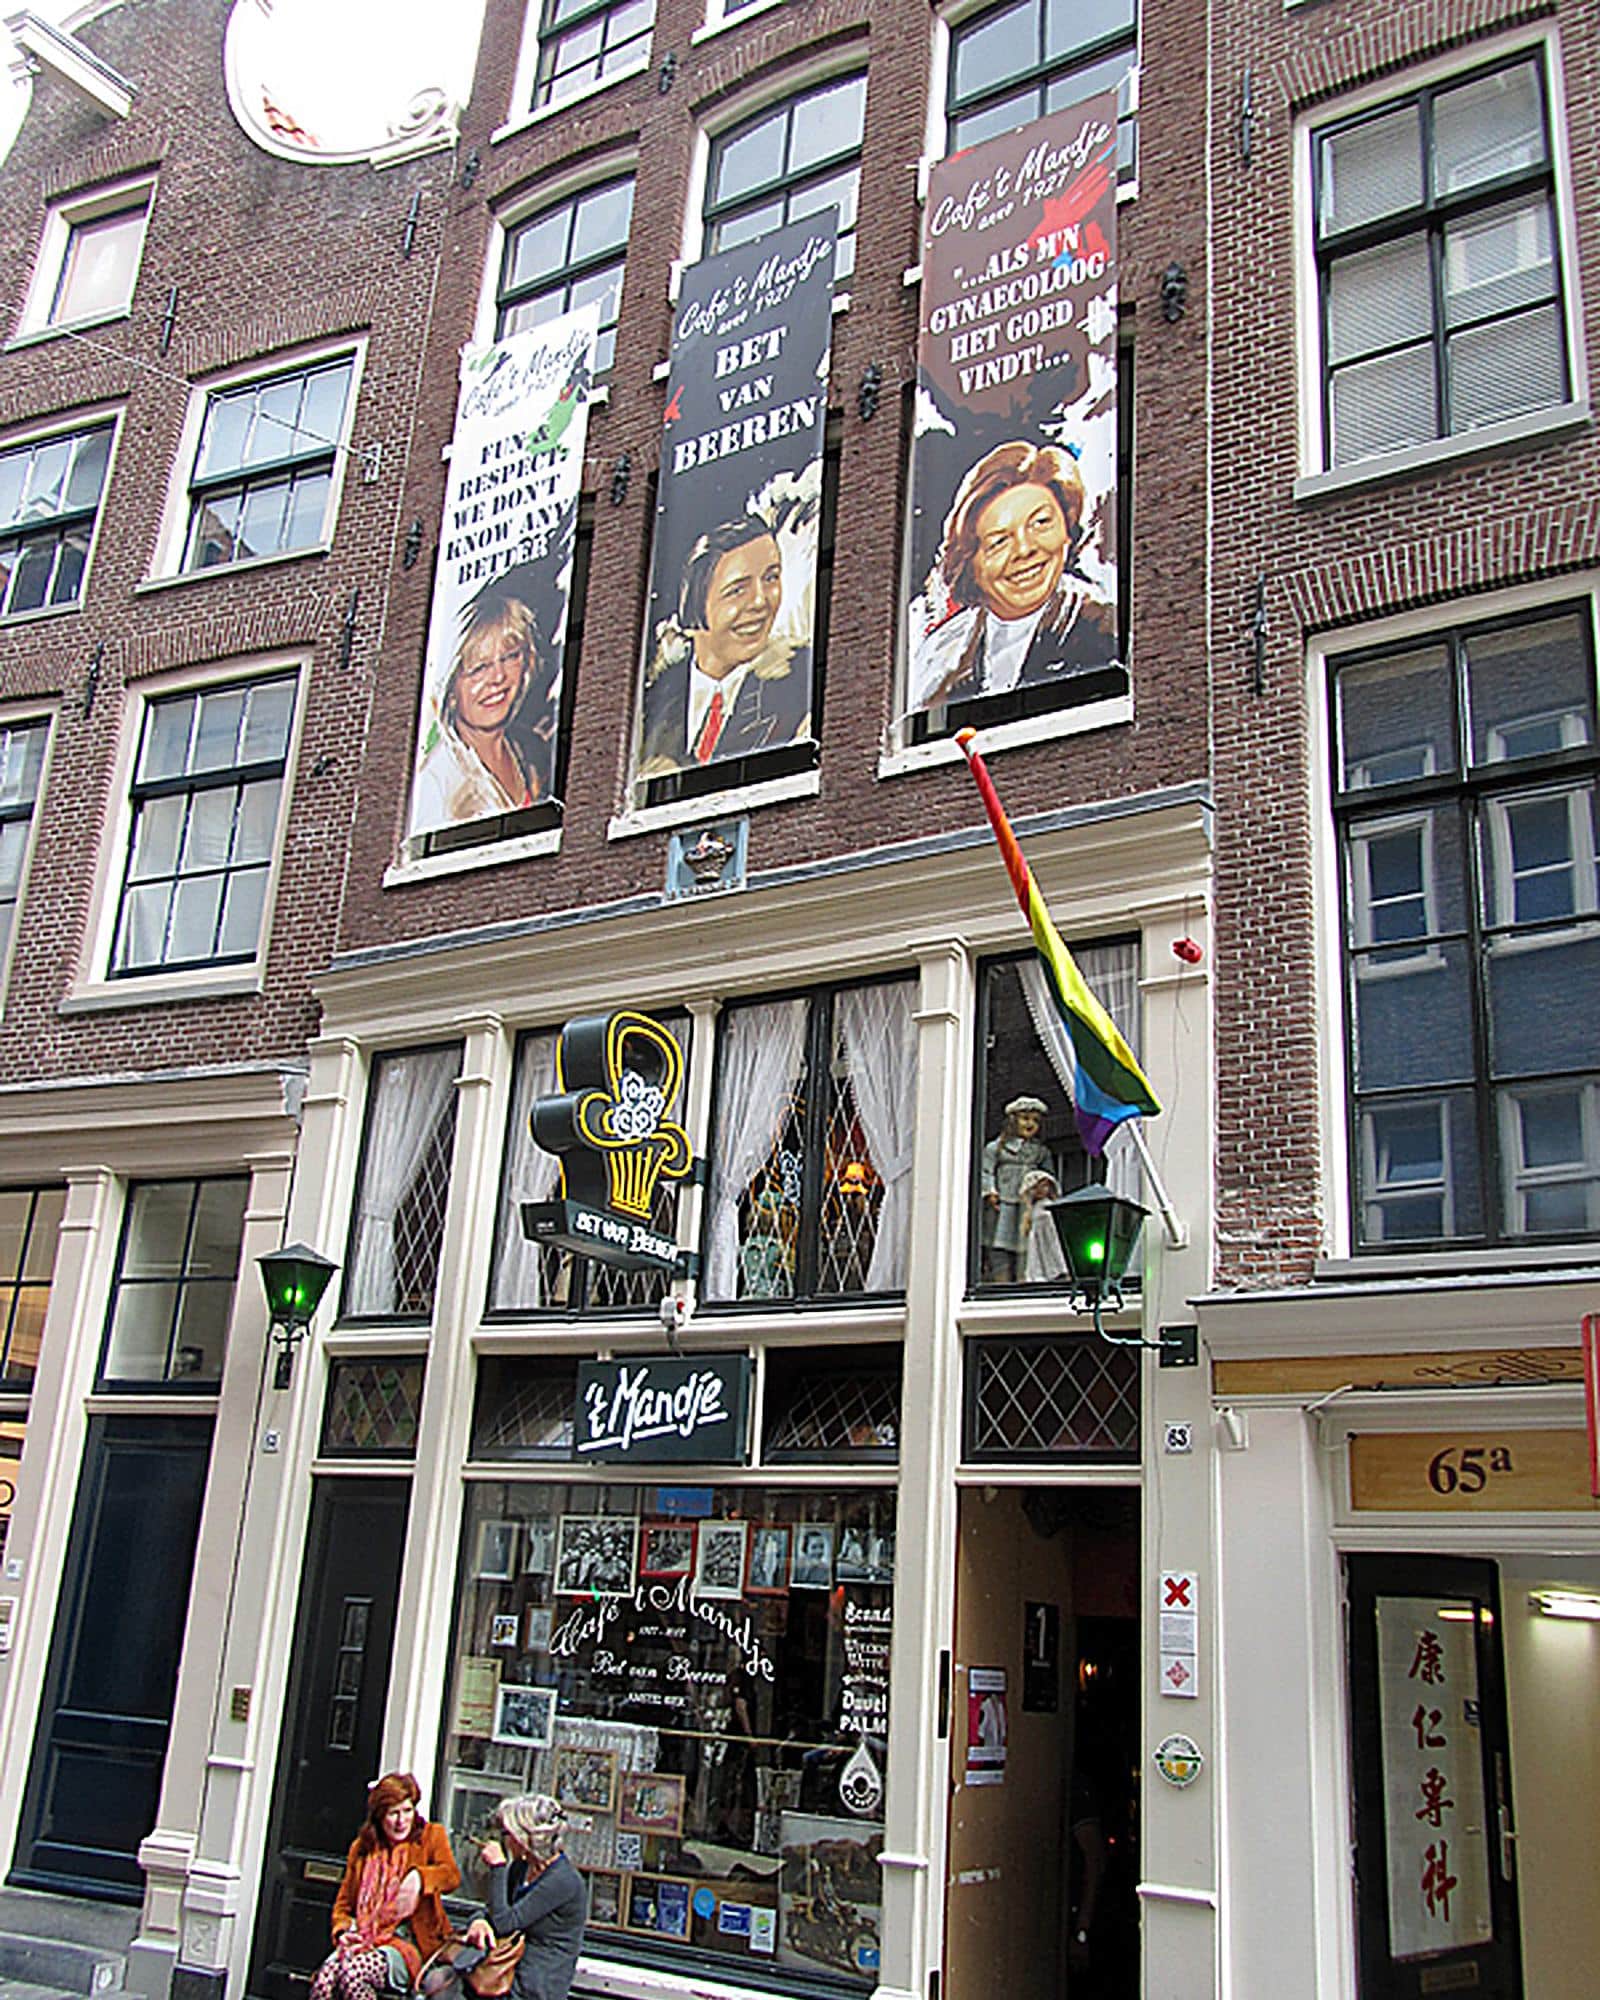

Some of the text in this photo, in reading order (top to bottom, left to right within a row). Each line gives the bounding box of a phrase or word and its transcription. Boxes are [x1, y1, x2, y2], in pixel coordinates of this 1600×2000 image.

[930, 179, 990, 237] Café
[1015, 120, 1111, 193] Mandje
[1023, 167, 1069, 206] 1927
[678, 289, 729, 340] Café
[749, 235, 833, 302] Mandje
[754, 279, 797, 314] 1927
[930, 251, 1106, 336] GYNAECOLOOG
[714, 325, 790, 380] BET
[950, 299, 1074, 364] HET GOED
[719, 375, 774, 413] VAN
[481, 424, 550, 465] FUN &
[672, 396, 818, 475] BEEREN
[453, 474, 561, 530] WE DON'T
[445, 498, 570, 562] KNOW ANY
[576, 1212, 603, 1235] BET
[608, 1367, 725, 1450] Mandje
[1167, 1427, 1188, 1448] 63
[1428, 1447, 1513, 1494] 65a
[591, 1650, 728, 1685] Bet van Beeren
[839, 1714, 888, 1735] PALM
[842, 1690, 887, 1714] Duvel
